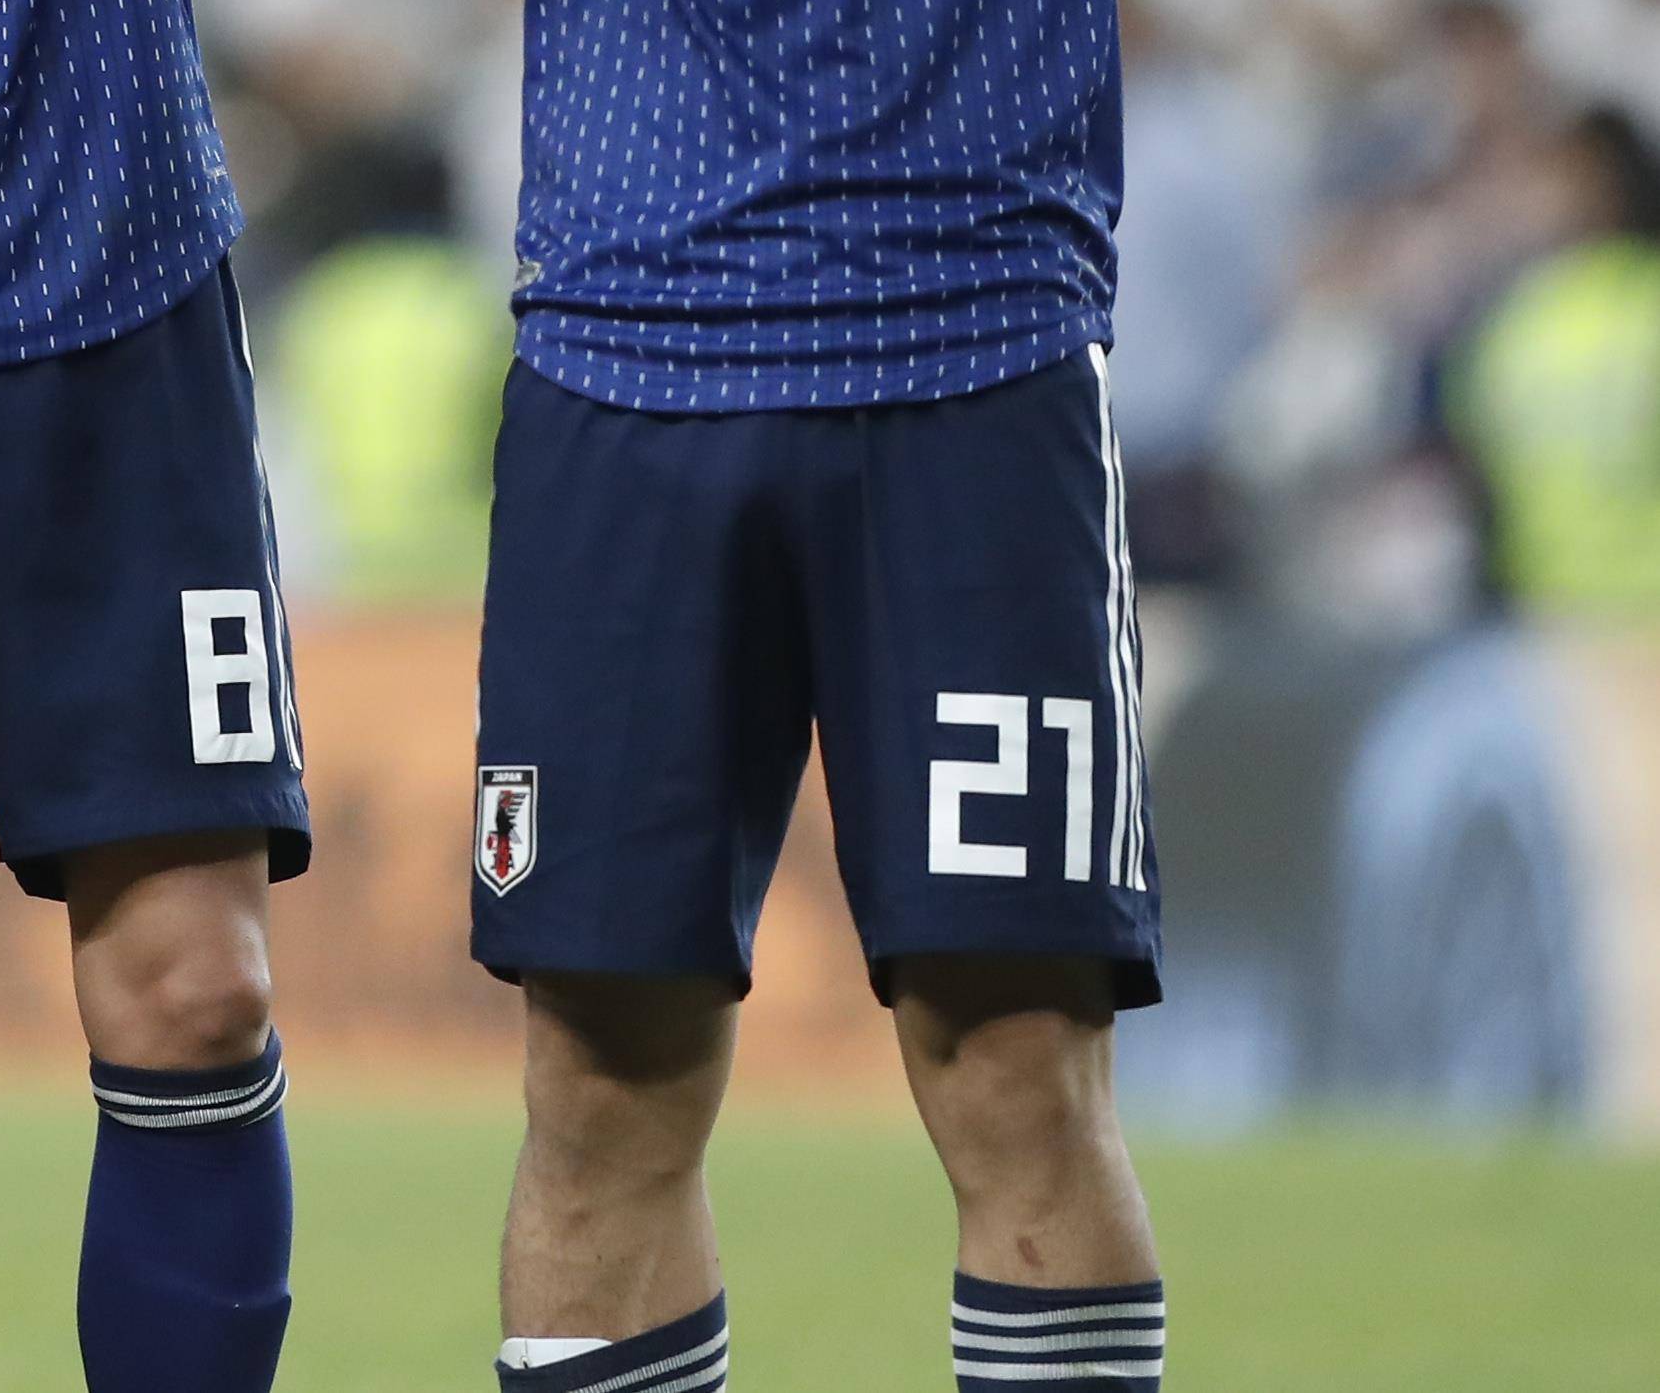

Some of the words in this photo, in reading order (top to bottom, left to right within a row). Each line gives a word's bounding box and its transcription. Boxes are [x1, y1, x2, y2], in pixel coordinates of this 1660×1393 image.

[180, 588, 276, 764] 8
[491, 772, 523, 783] JAPAN
[929, 692, 1092, 882] 21
